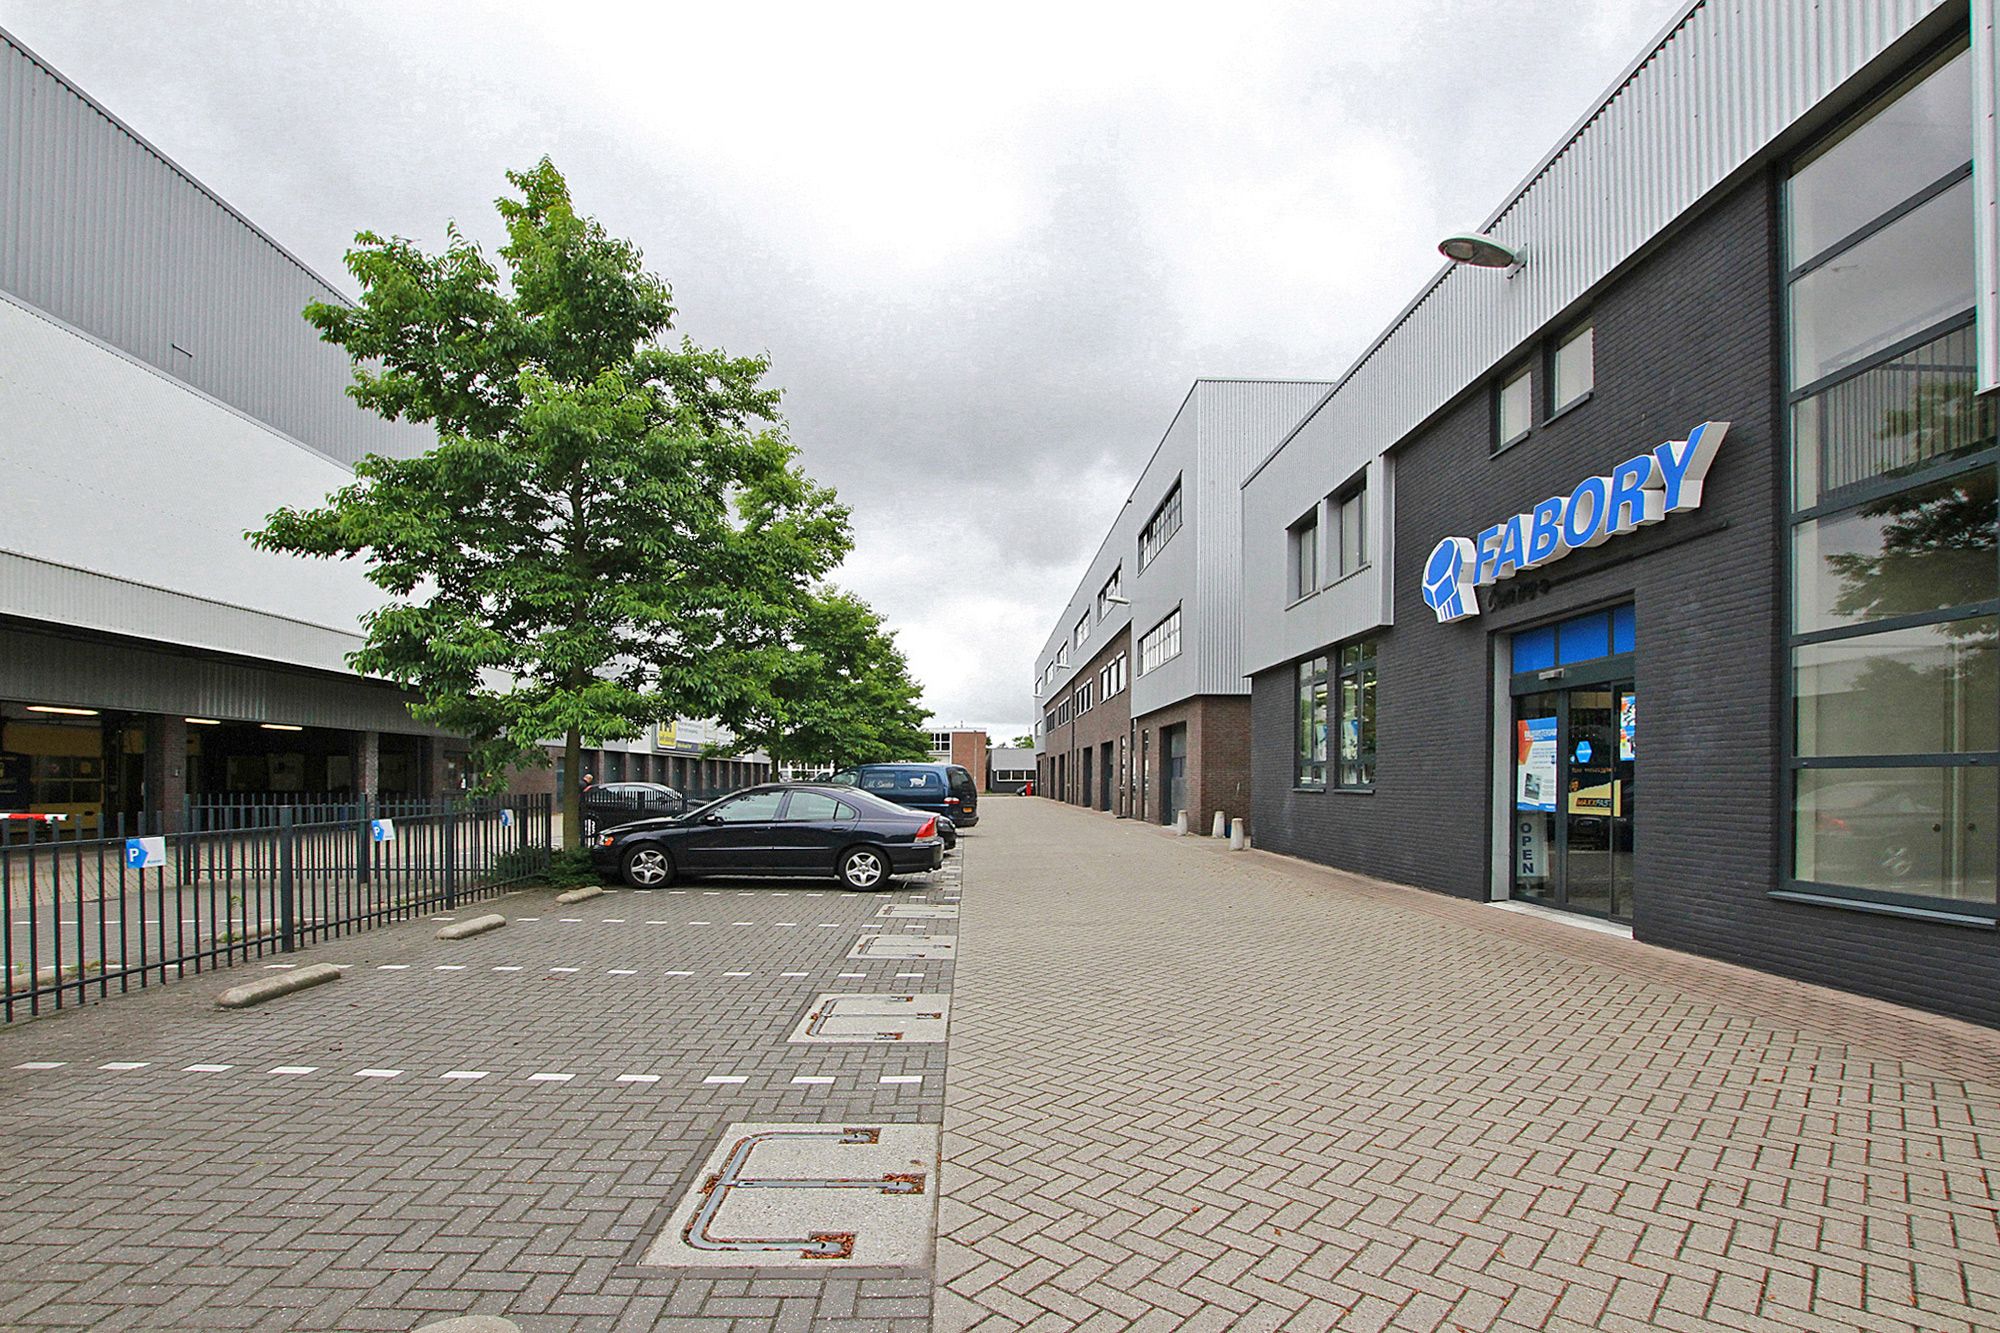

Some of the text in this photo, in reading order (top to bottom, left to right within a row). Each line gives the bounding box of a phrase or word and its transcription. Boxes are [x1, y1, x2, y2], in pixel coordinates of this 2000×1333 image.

[1473, 421, 1730, 588] FABORY
[129, 847, 140, 862] P
[1520, 822, 1535, 874] OPEN
